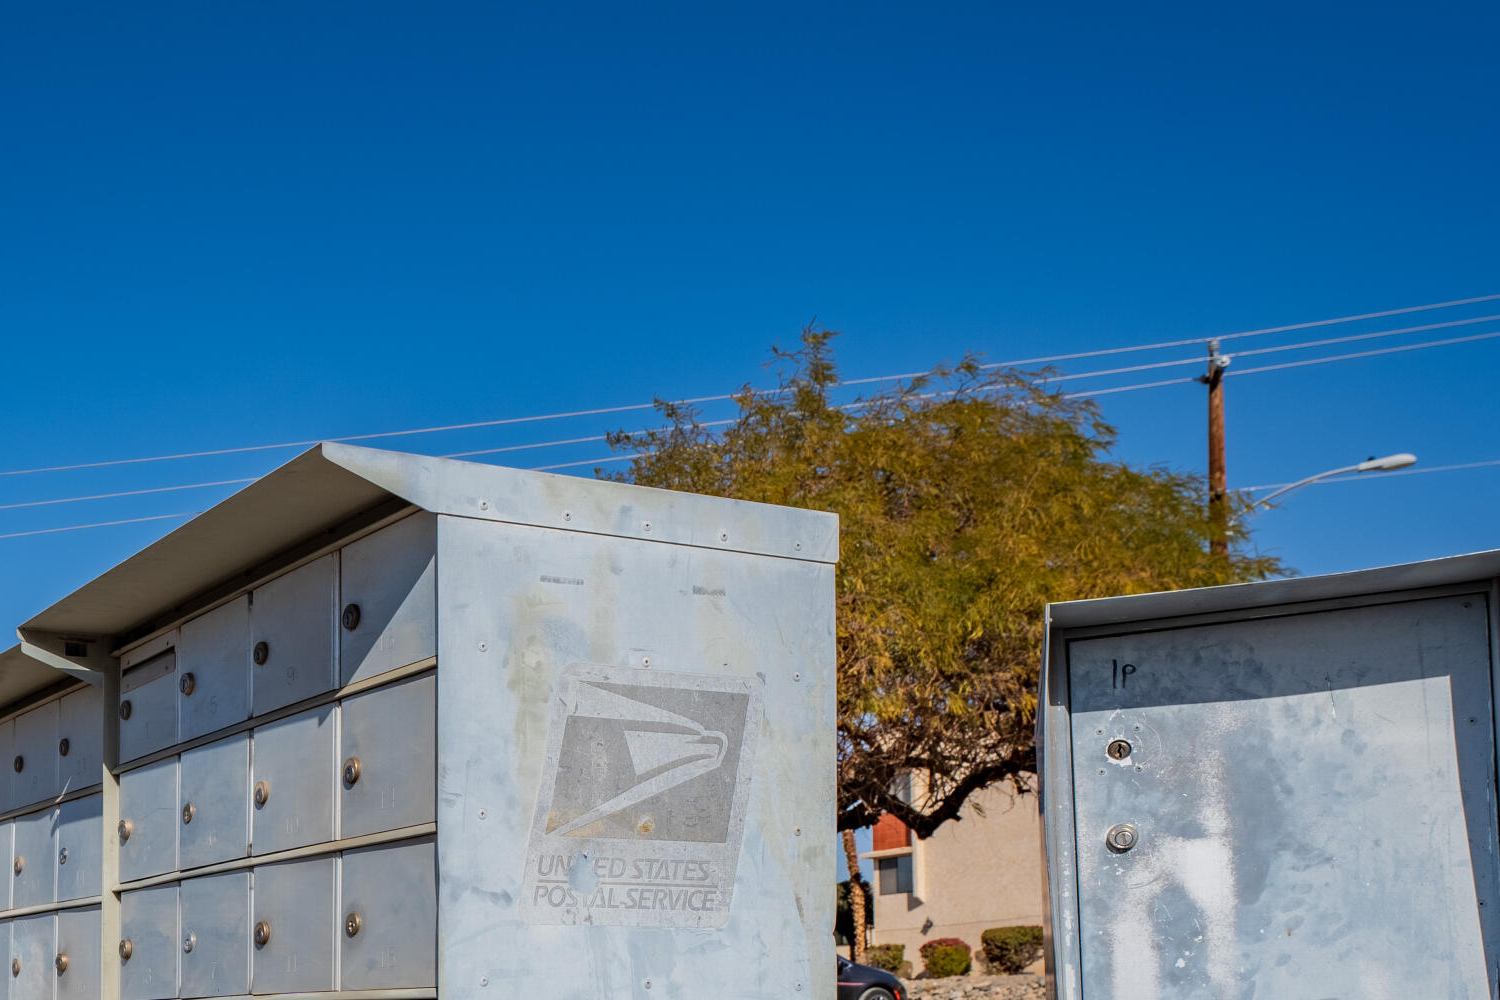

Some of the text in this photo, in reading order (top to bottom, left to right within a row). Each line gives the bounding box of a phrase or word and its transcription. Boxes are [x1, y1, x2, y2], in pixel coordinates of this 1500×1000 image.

[284, 664, 296, 685] 9
[537, 854, 711, 882] UNED STATES
[621, 887, 718, 912] SERVICE
